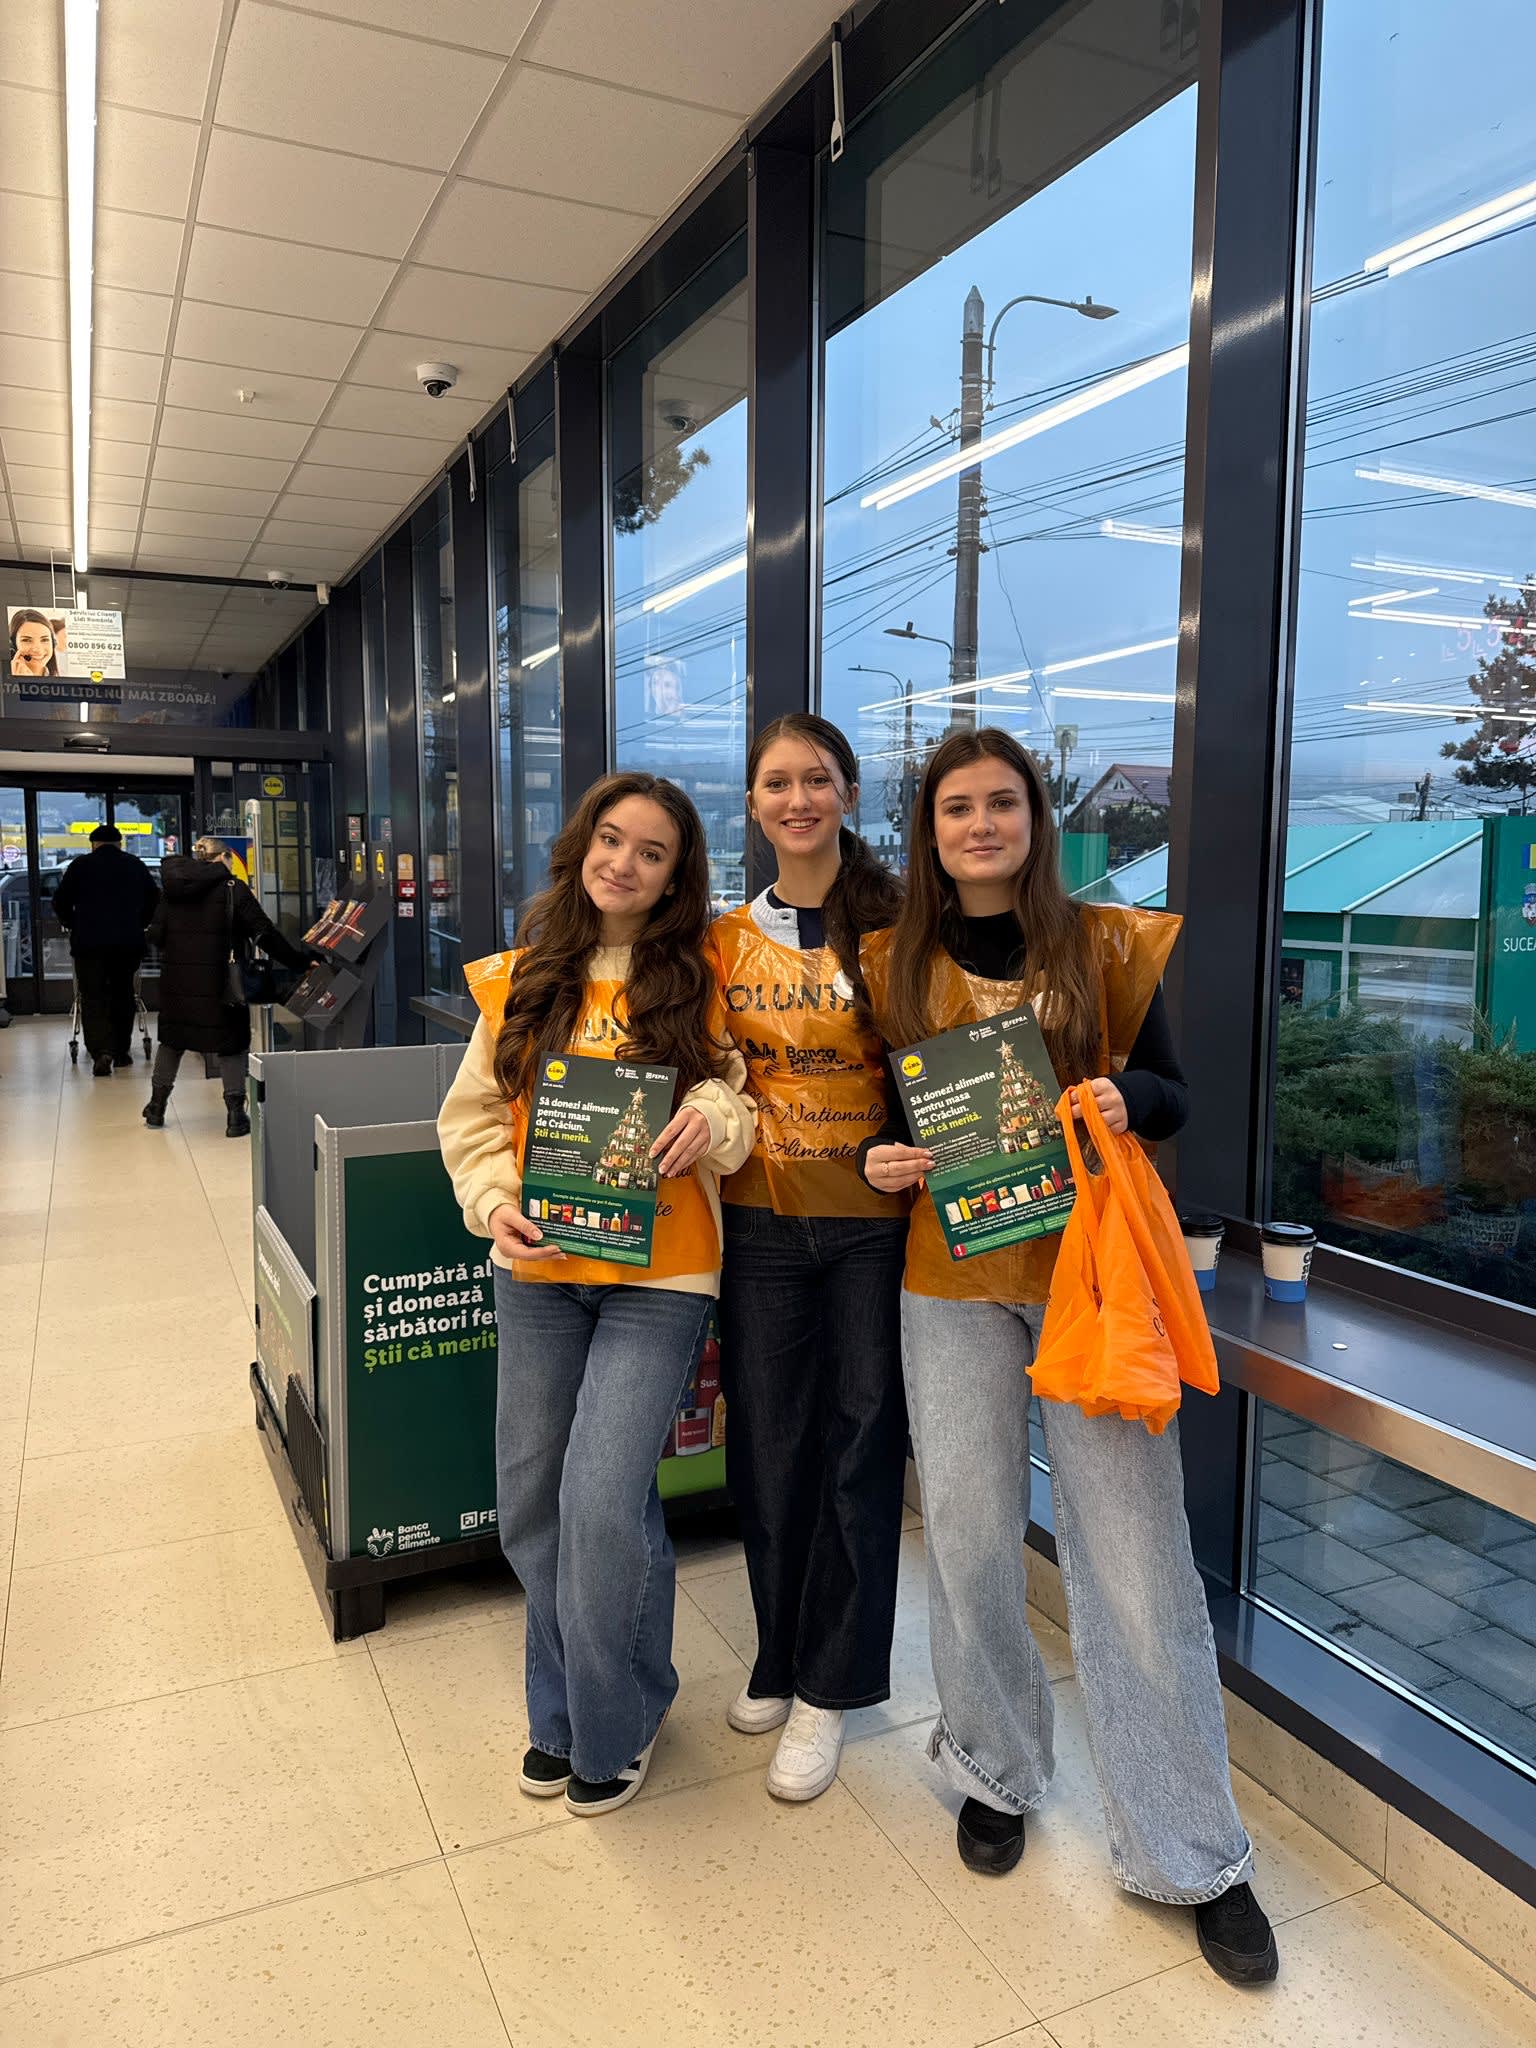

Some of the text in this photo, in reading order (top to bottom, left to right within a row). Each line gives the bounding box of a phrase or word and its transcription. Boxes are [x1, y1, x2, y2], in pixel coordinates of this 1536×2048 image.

[71, 686, 102, 698] LIDL
[104, 688, 124, 700] NU
[128, 690, 156, 701] MAI
[785, 1045, 837, 1058] Banca
[910, 1071, 995, 1106] Să donezi alimente
[539, 1096, 620, 1115] Să donezi alimente
[913, 1092, 971, 1118] pentru masa
[536, 1118, 584, 1131] de Crăciun.
[537, 1109, 591, 1122] pentru masa
[779, 1102, 888, 1129] Națională
[917, 1105, 969, 1127] de Crăciun.
[936, 1123, 948, 1133] că
[949, 1112, 982, 1129] merită.
[550, 1130, 560, 1139] că
[561, 1132, 592, 1144] merită.
[769, 1136, 858, 1159] Alimente
[363, 1262, 468, 1294] Cumpără
[364, 1284, 484, 1324] și donează
[364, 1309, 467, 1344] sărbători
[364, 1330, 496, 1374] Știi că merit
[700, 1379, 718, 1389] Suc
[480, 1509, 497, 1524] FE
[398, 1523, 429, 1534] Banca
[398, 1530, 430, 1544] pentru
[398, 1536, 441, 1550] alimente
